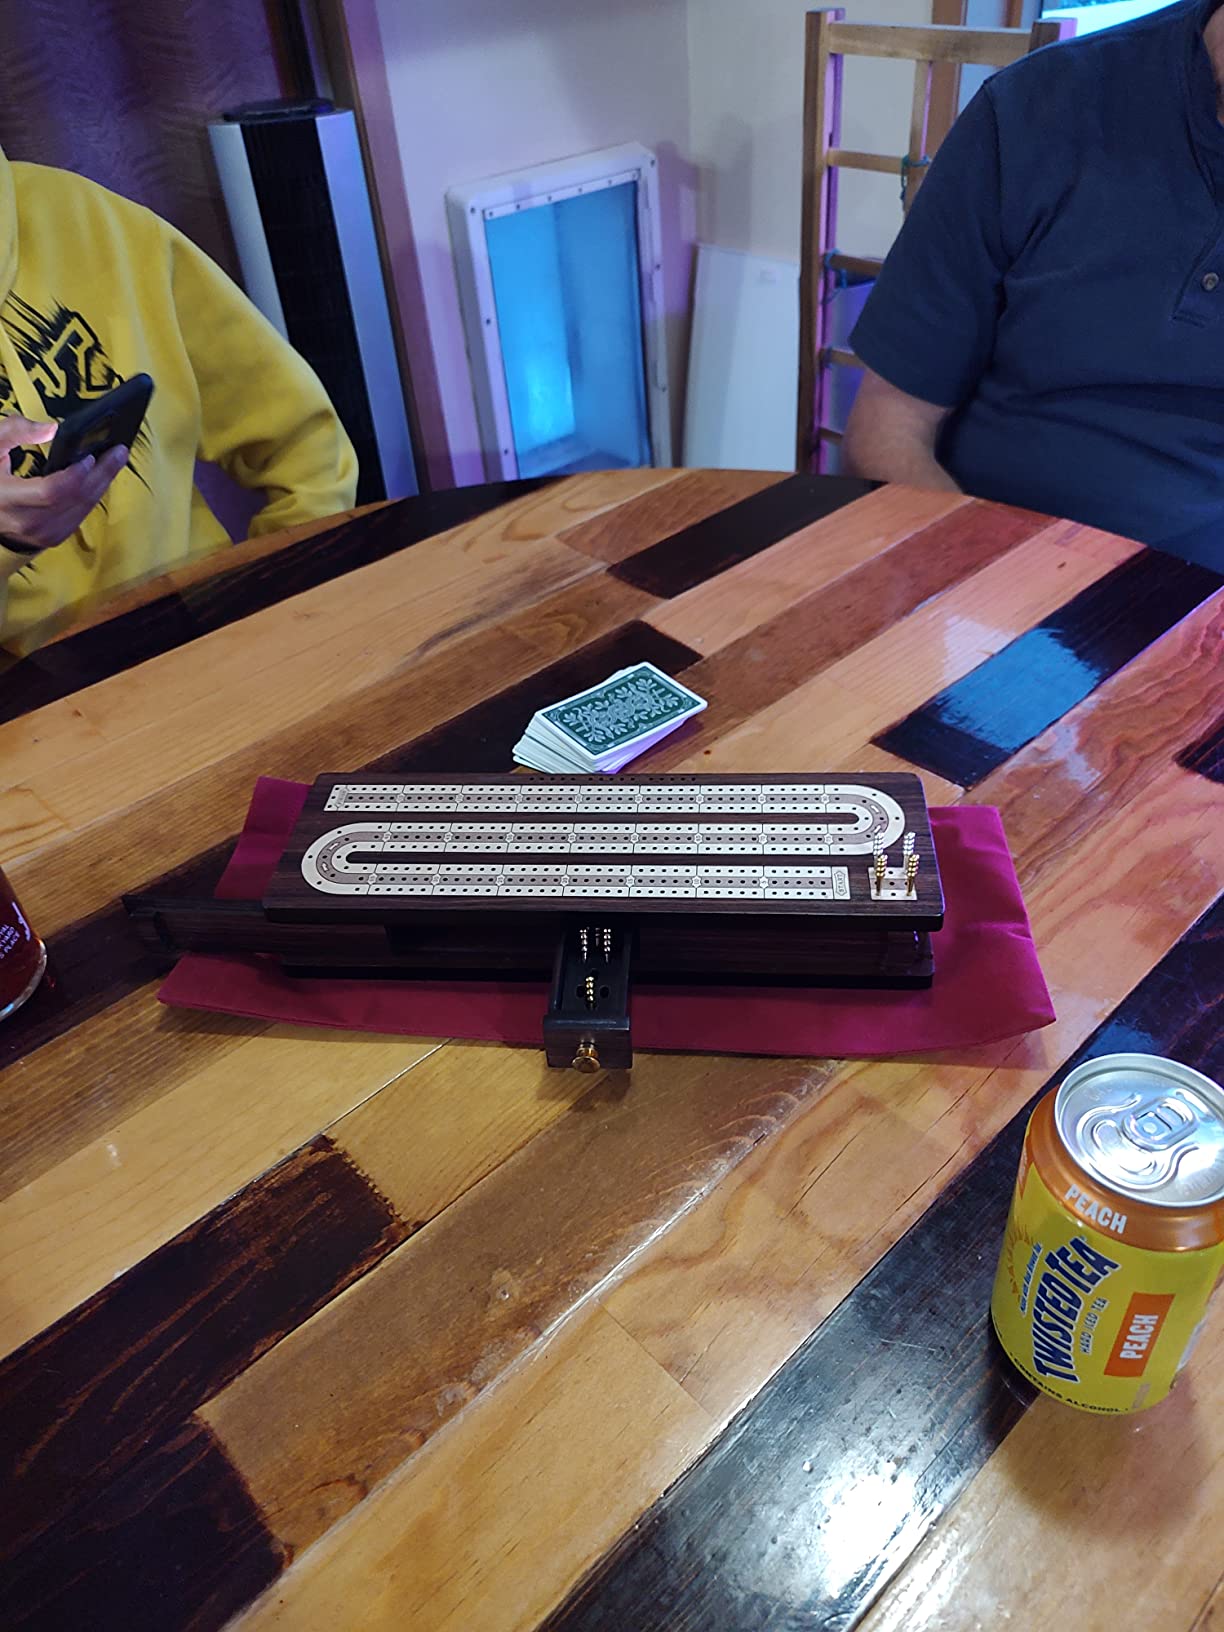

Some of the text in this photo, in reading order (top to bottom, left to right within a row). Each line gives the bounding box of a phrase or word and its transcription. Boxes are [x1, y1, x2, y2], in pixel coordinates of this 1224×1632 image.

[1065, 1184, 1127, 1234] PEACH
[1032, 1236, 1121, 1383] TWISTED TEA
[1120, 1314, 1159, 1359] PEACH
[1065, 1398, 1121, 1413] ALCOHOL
